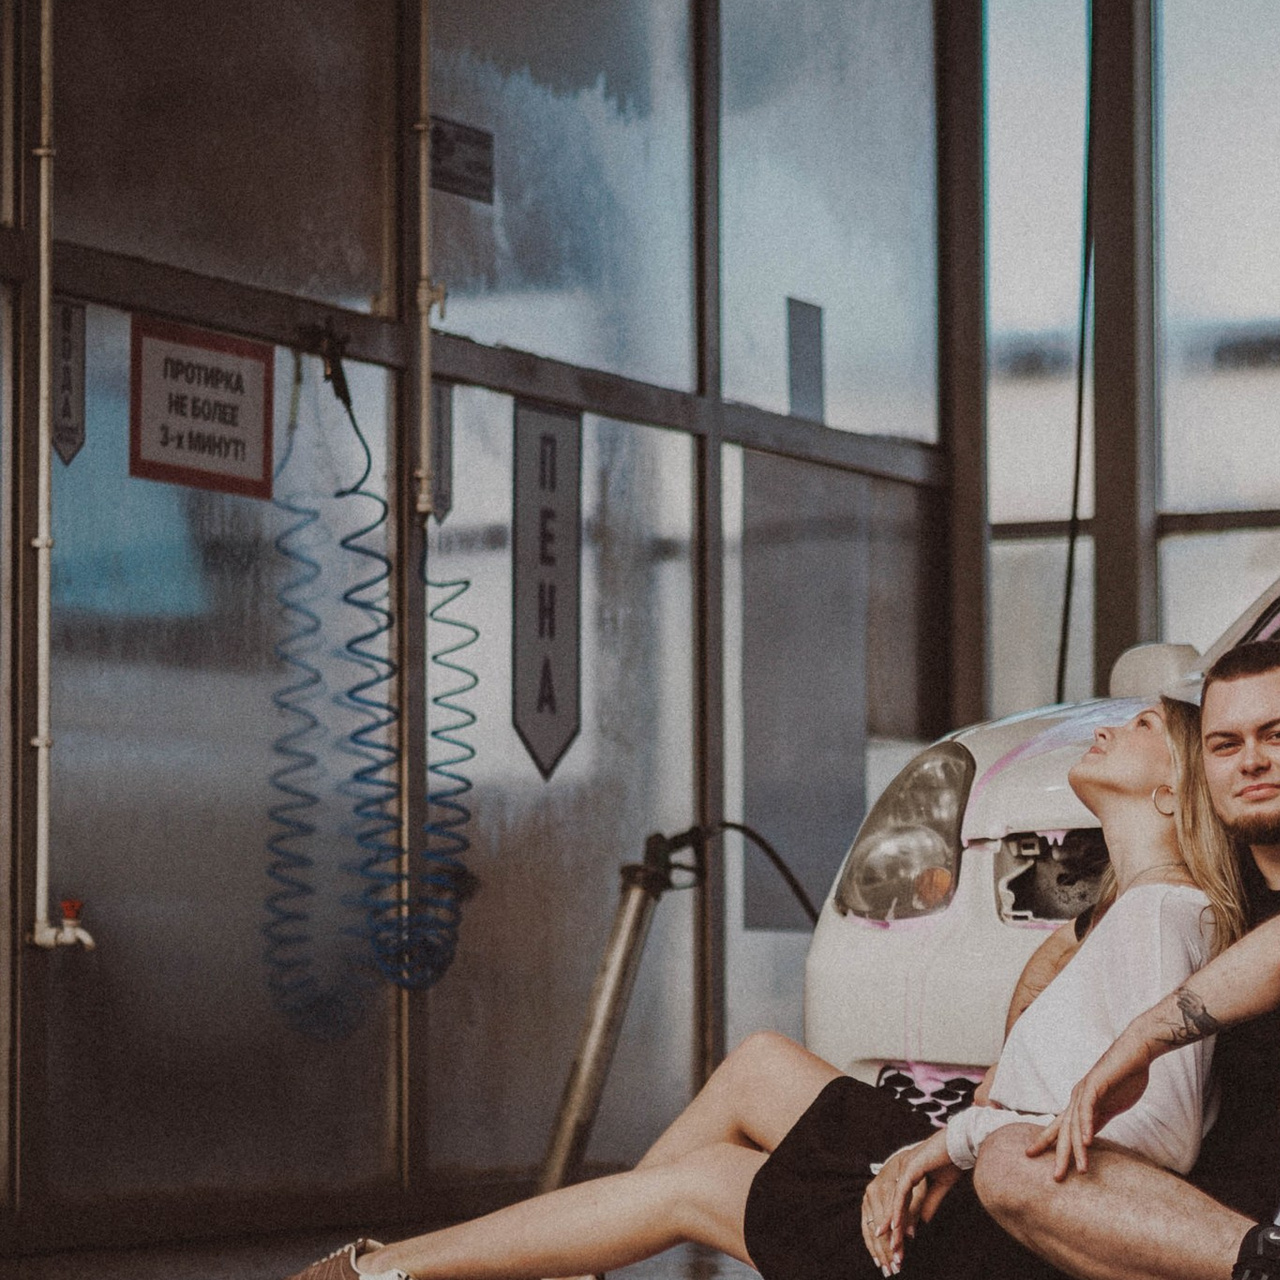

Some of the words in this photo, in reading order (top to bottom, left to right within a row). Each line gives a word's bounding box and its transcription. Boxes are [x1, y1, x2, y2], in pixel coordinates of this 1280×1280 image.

[163, 356, 245, 395] ПРОТИРКА
[168, 392, 188, 417] НЕ
[191, 396, 240, 427] БОЛЕЕ
[188, 428, 246, 462] МИНУТ!
[536, 433, 557, 714] ПЕНА
